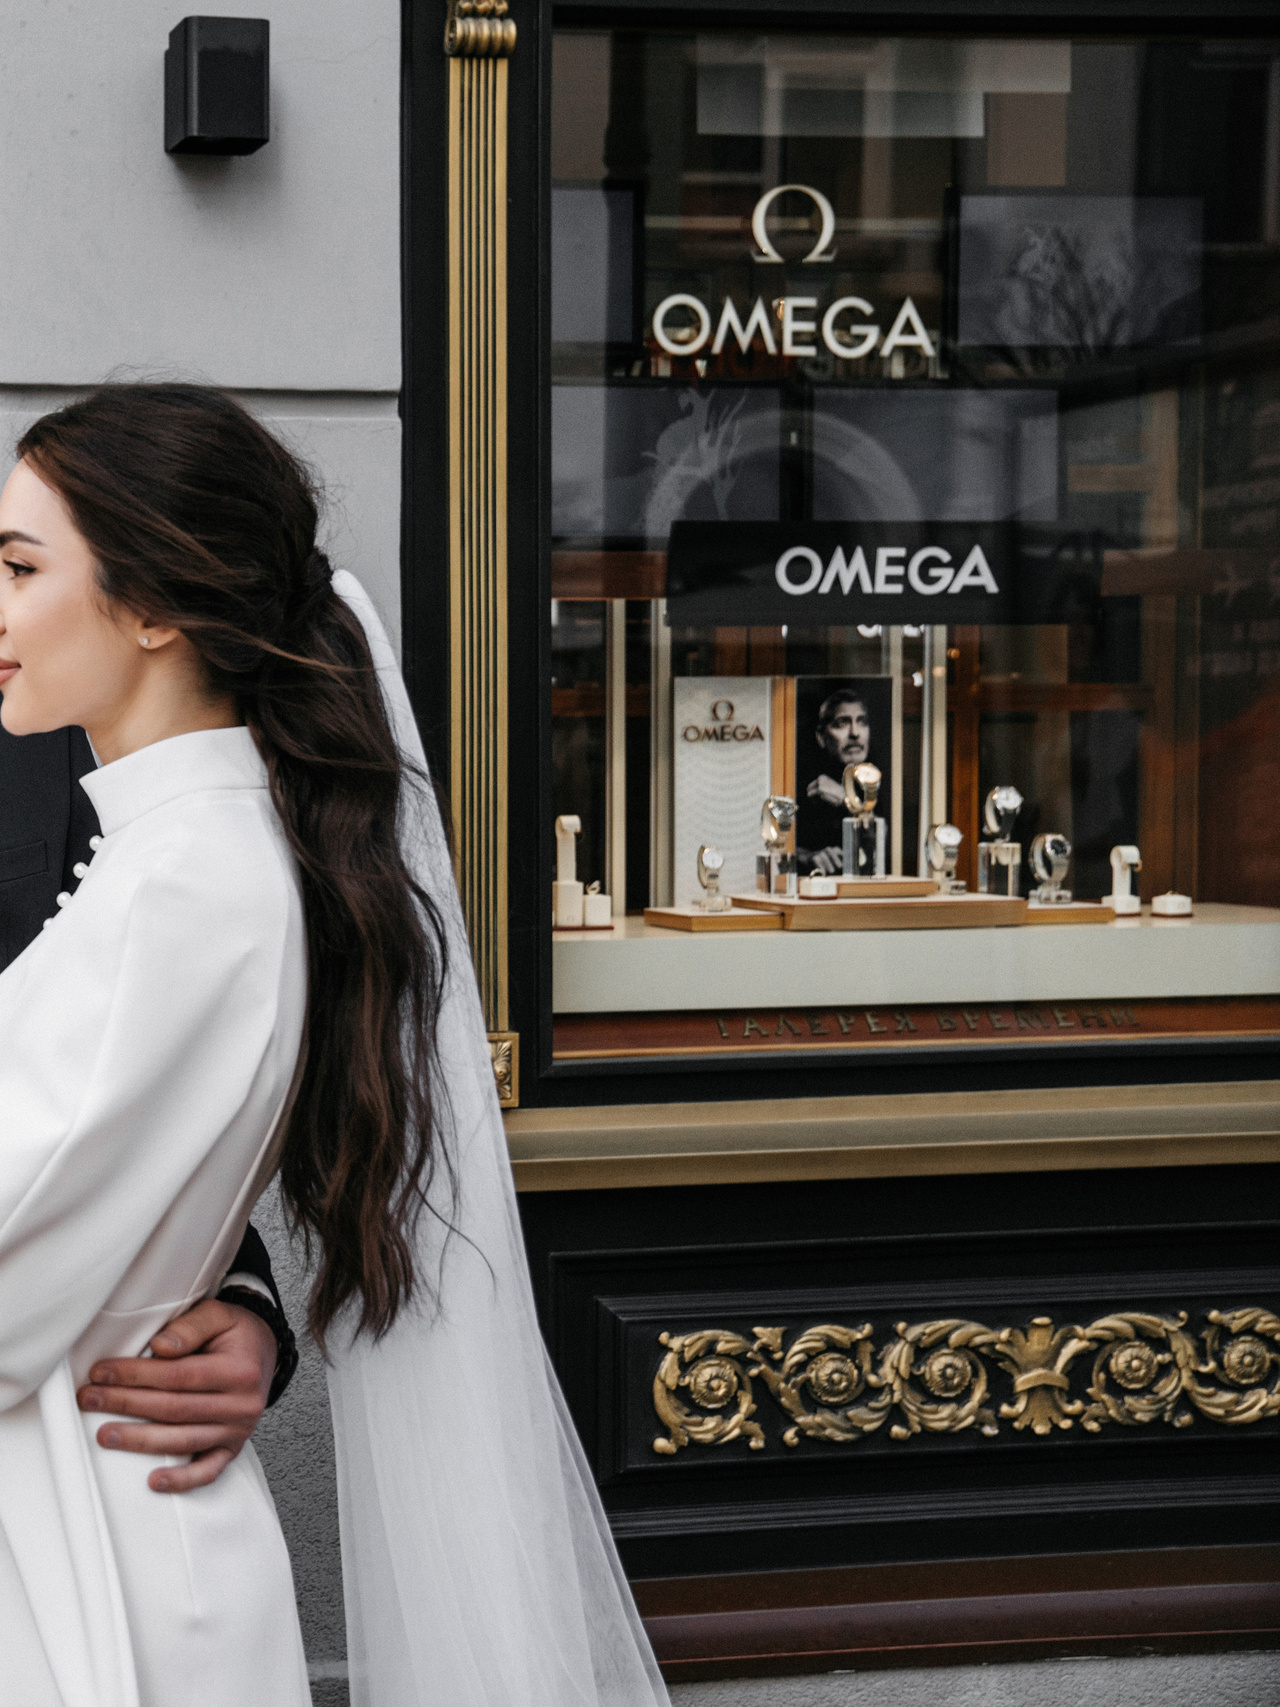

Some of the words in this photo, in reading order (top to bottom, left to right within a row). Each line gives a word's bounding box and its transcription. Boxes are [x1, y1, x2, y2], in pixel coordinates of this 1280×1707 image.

[652, 293, 936, 359] OMEGA
[774, 544, 1000, 596] OMEGA
[683, 723, 765, 743] OMEGA
[717, 1009, 919, 1038] ГАЛЕРЕЯ
[936, 1004, 1141, 1032] ВРЕМЕНИ
